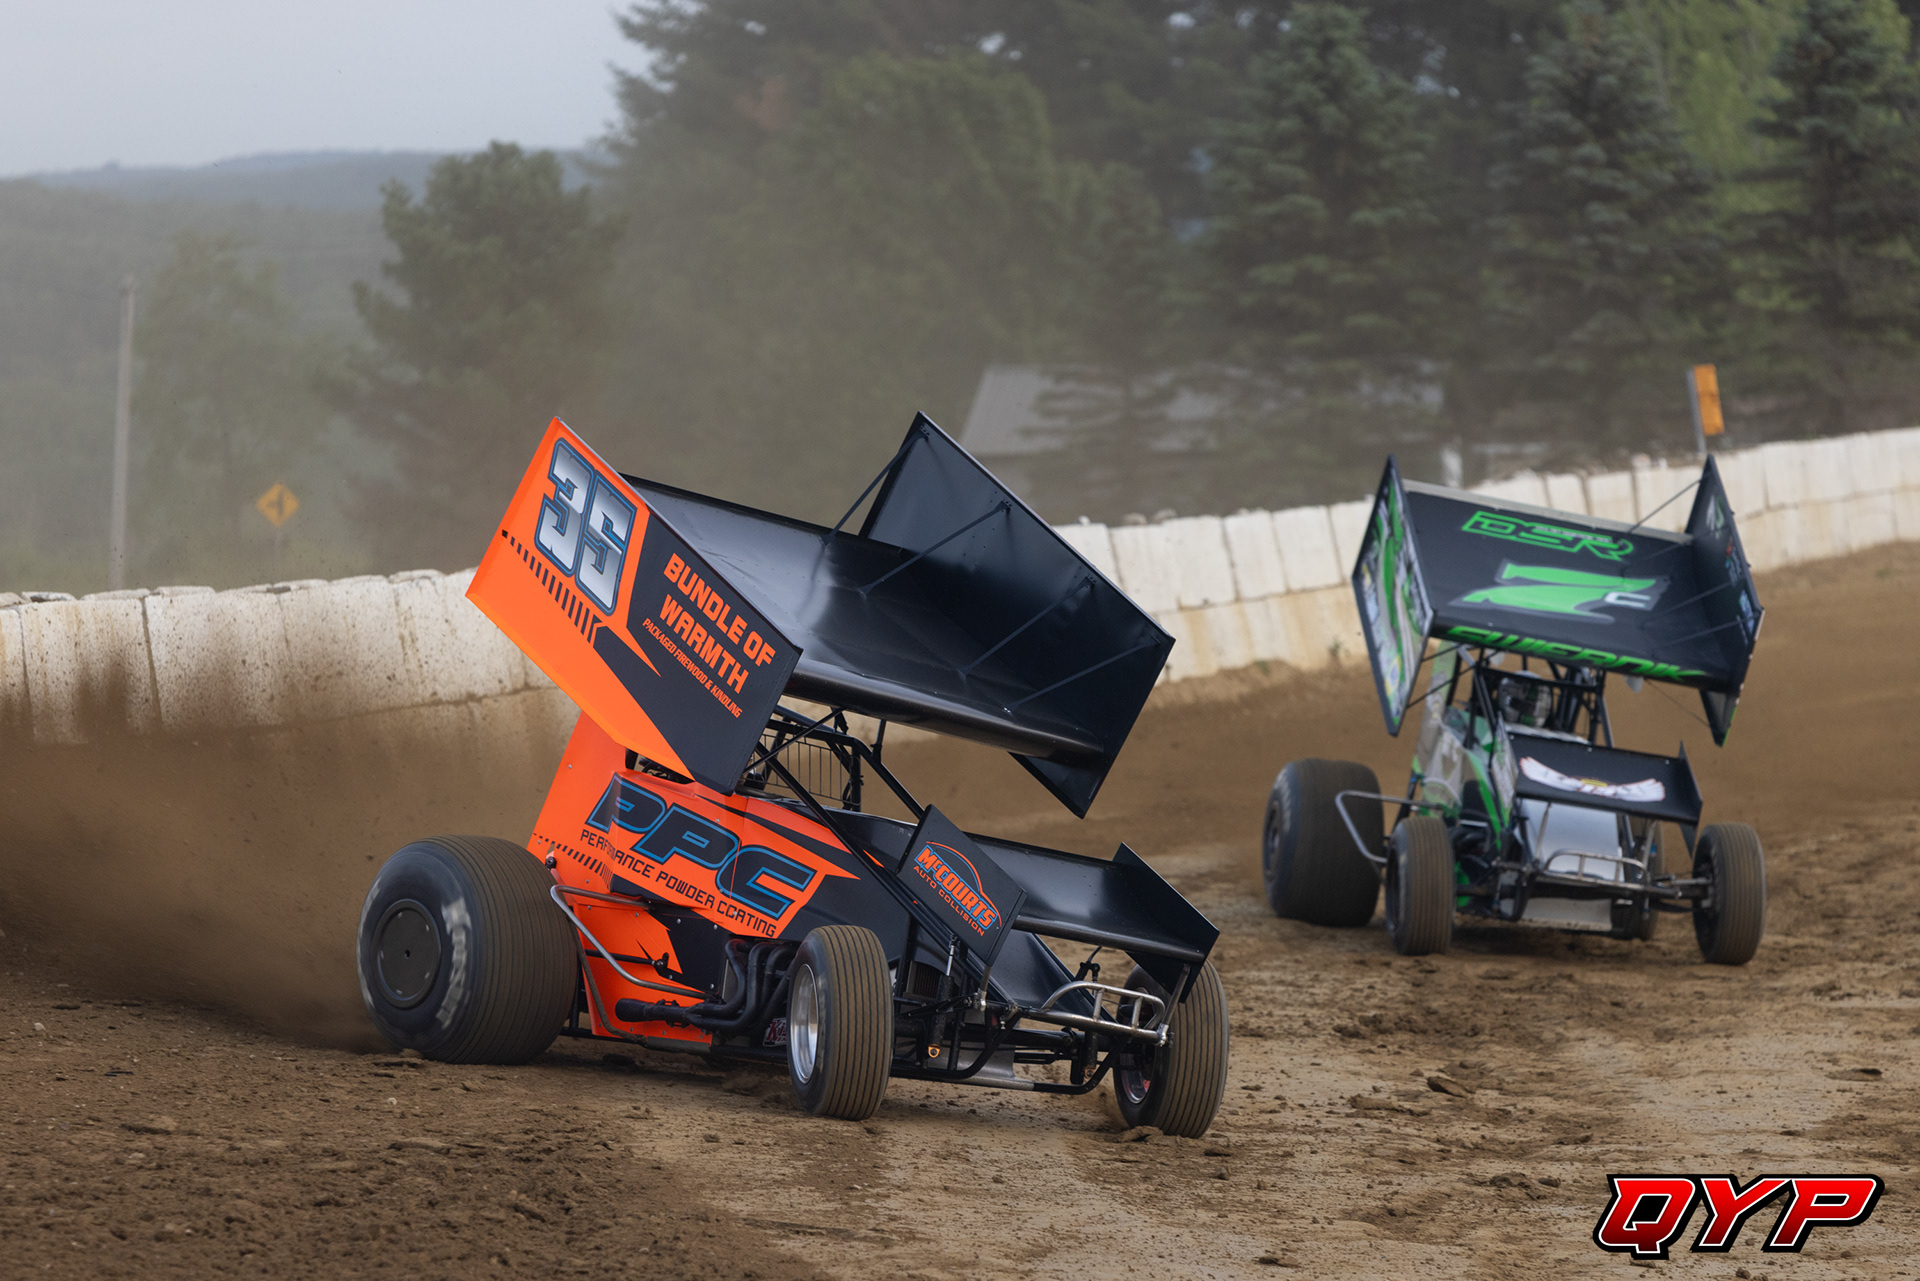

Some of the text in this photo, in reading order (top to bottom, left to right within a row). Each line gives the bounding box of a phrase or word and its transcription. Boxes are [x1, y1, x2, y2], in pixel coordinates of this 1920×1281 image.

[534, 437, 638, 617] 35
[1461, 510, 1634, 561] DSR
[659, 593, 749, 694] WARMTH
[663, 552, 776, 667] BUNDLE OF
[642, 618, 743, 718] PACKAGED FIREWOOD & KINDLING
[580, 829, 777, 938] PERFANCE POWDER COATING
[585, 772, 818, 921] PPC
[913, 865, 985, 936] AUTO COLLISION
